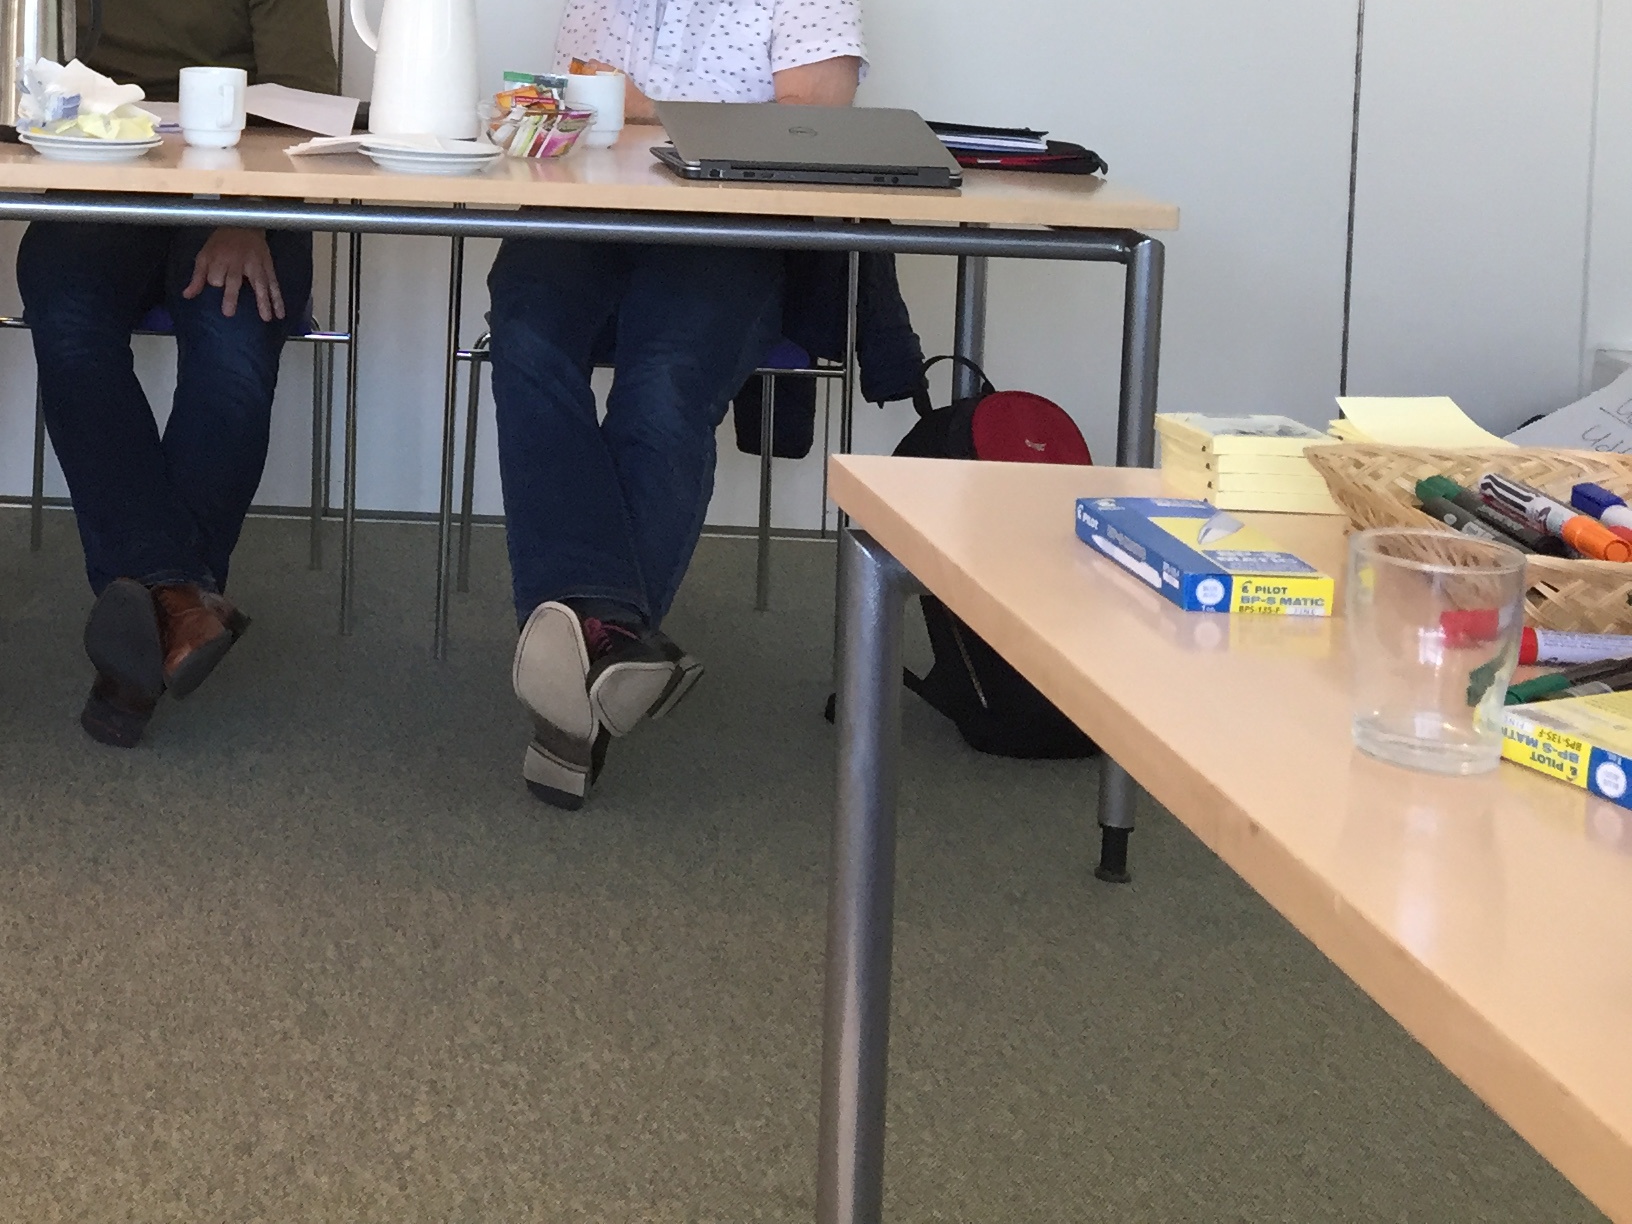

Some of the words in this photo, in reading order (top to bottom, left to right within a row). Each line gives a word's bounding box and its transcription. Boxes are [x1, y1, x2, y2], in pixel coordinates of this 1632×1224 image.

[1255, 585, 1288, 595] PILOT
[1240, 596, 1276, 605] BP-S
[1280, 598, 1325, 607] MATIC
[1538, 728, 1582, 752] BPS-135-F
[1530, 751, 1564, 772] PILOT
[1542, 742, 1579, 764] BP-S
